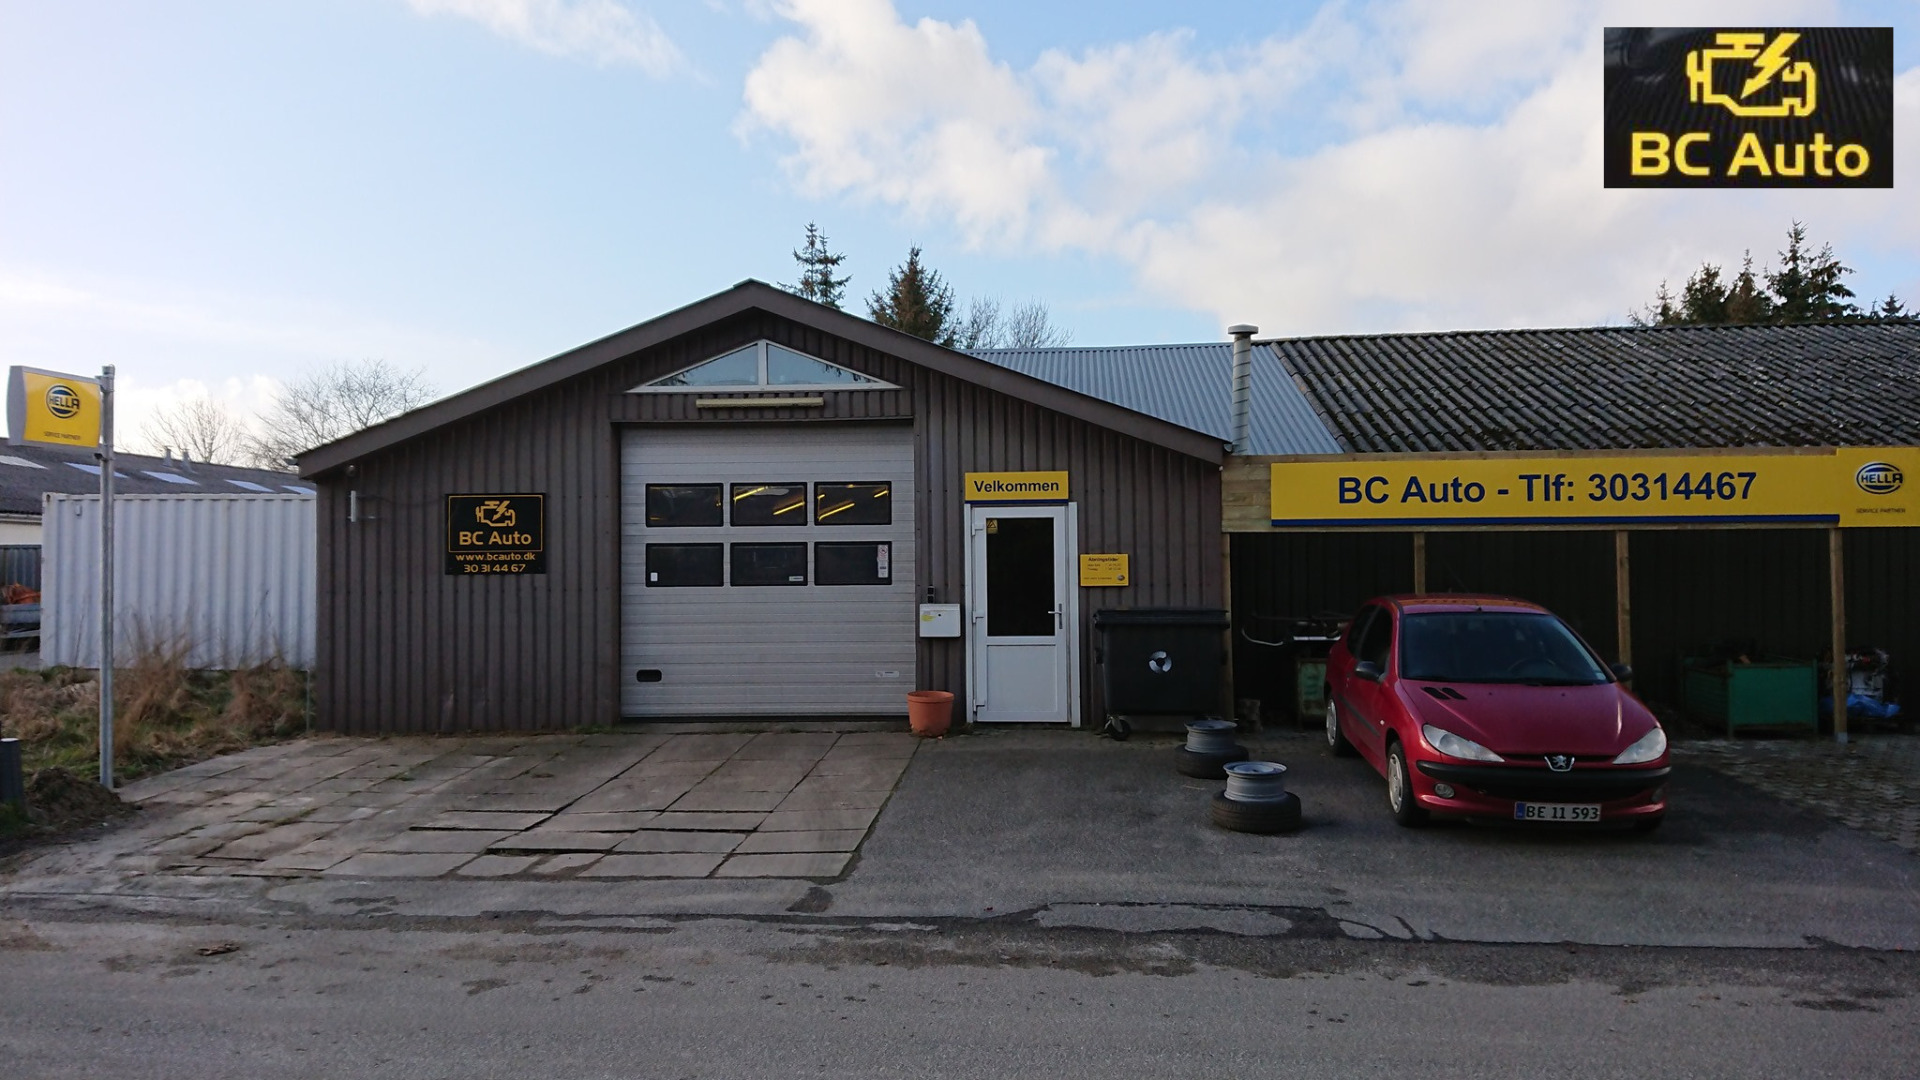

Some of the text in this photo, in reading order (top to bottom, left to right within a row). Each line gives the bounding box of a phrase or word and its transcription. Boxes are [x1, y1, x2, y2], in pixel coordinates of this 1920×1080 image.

[49, 396, 80, 410] HELLA
[1860, 472, 1904, 485] HELLA
[973, 480, 1059, 493] Velkommen
[1338, 476, 1390, 504] BC
[1400, 475, 1486, 504] Auto
[1518, 473, 1575, 502] Tlf:
[1587, 471, 1757, 502] 30314467
[1855, 507, 1906, 515] SERVICE PARTNER
[459, 531, 532, 546] BC Auto
[455, 552, 536, 561] www.bcauto.dk
[463, 564, 479, 573] 30
[492, 564, 509, 573] 44
[510, 563, 527, 573] 67
[1525, 805, 1599, 820] BE 11 593
